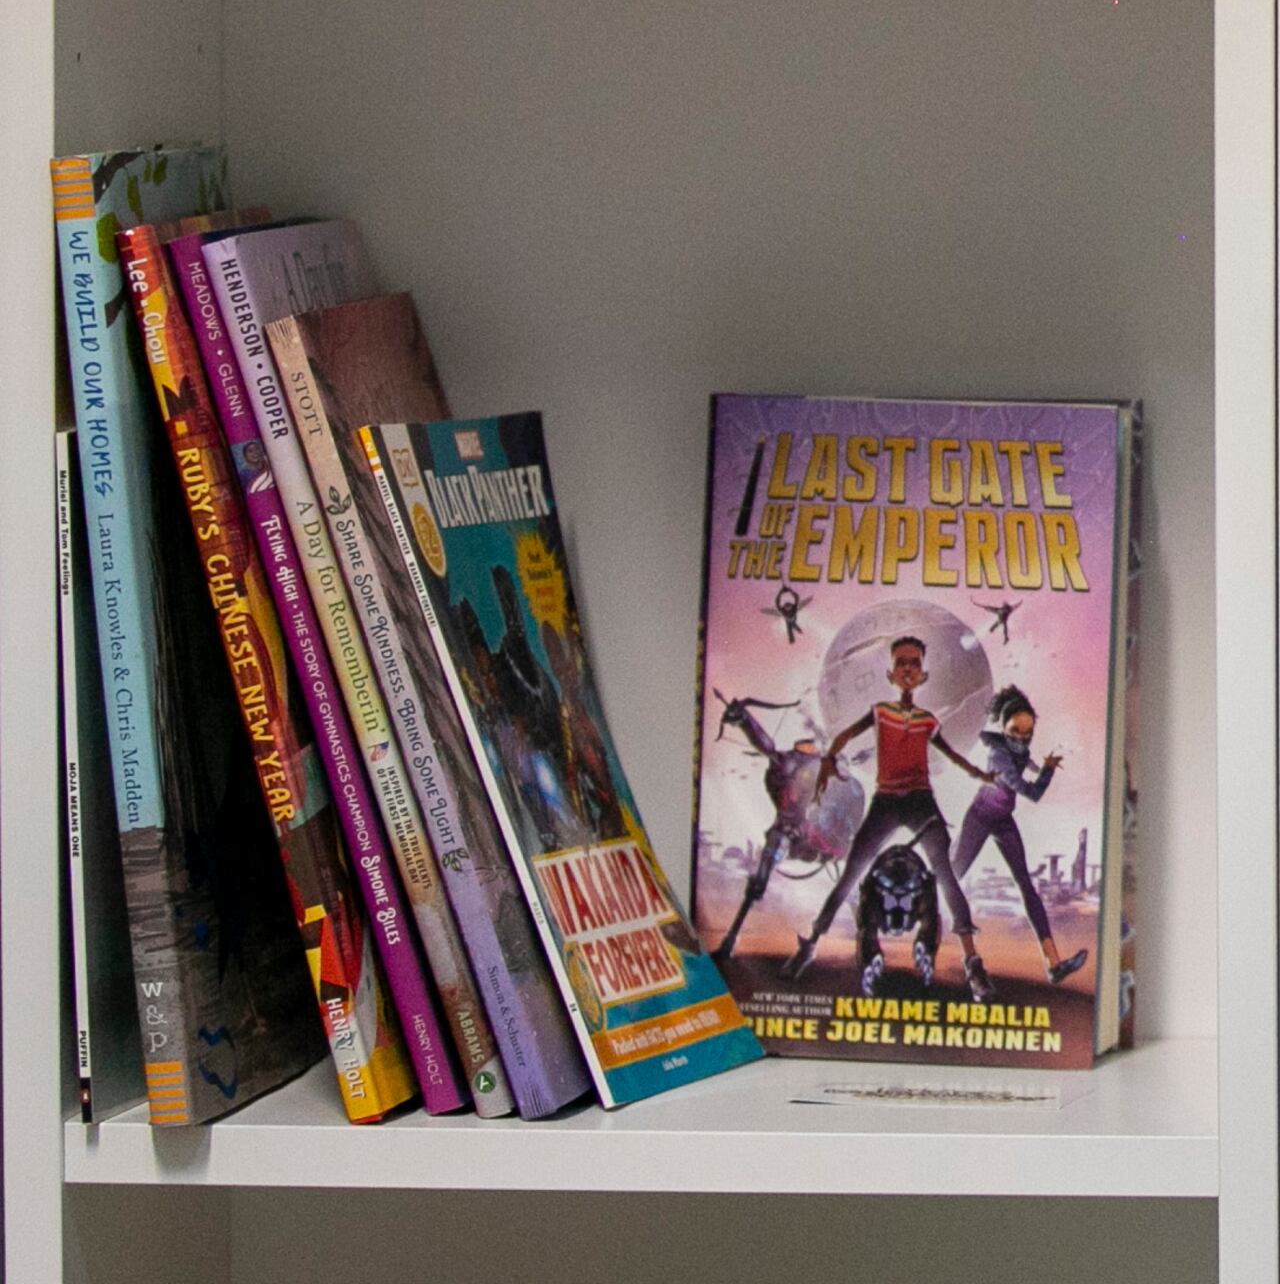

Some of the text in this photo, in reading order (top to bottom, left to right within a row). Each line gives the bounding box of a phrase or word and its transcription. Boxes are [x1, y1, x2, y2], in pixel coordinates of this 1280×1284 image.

[288, 370, 324, 440] STOTT
[217, 257, 388, 739] HENDERSON COOPER A Day for Rememberin'
[424, 469, 482, 528] BLACK
[468, 465, 550, 525] PANTHER
[767, 433, 1073, 508] LAST GATE
[72, 231, 143, 823] WE BUILD OUR HOMES Laura Knowles & Chris Madden
[334, 516, 368, 571] SHARE
[759, 505, 794, 537] OF
[727, 506, 1089, 592] THE EMPEROR
[351, 570, 385, 618] SOME
[127, 257, 367, 1100] Lee Chou RUBY'S CHINESE NEW YEAR HENRY HOLT
[185, 260, 443, 1086] MEADOWS GLENN FLYING HIGH THE STORY OF GYMNASTICS CHAMPION SIMONE BILES HENRY HOLT
[395, 697, 429, 752] BRING
[59, 468, 88, 1067] Muriel and Tom Feelings MOJA MEANS ONE PUFFIN
[411, 753, 444, 801] SOME
[427, 797, 459, 847] LIGHT
[536, 846, 673, 937] WAKANDA
[485, 965, 509, 1004] Simon
[498, 1004, 512, 1016] &
[455, 1009, 485, 1064] ABRAMS
[826, 1020, 1061, 1053] JOEL MAKONNEN
[835, 997, 1050, 1028] KWAME MBALIA
[501, 1016, 530, 1069] Schuster
